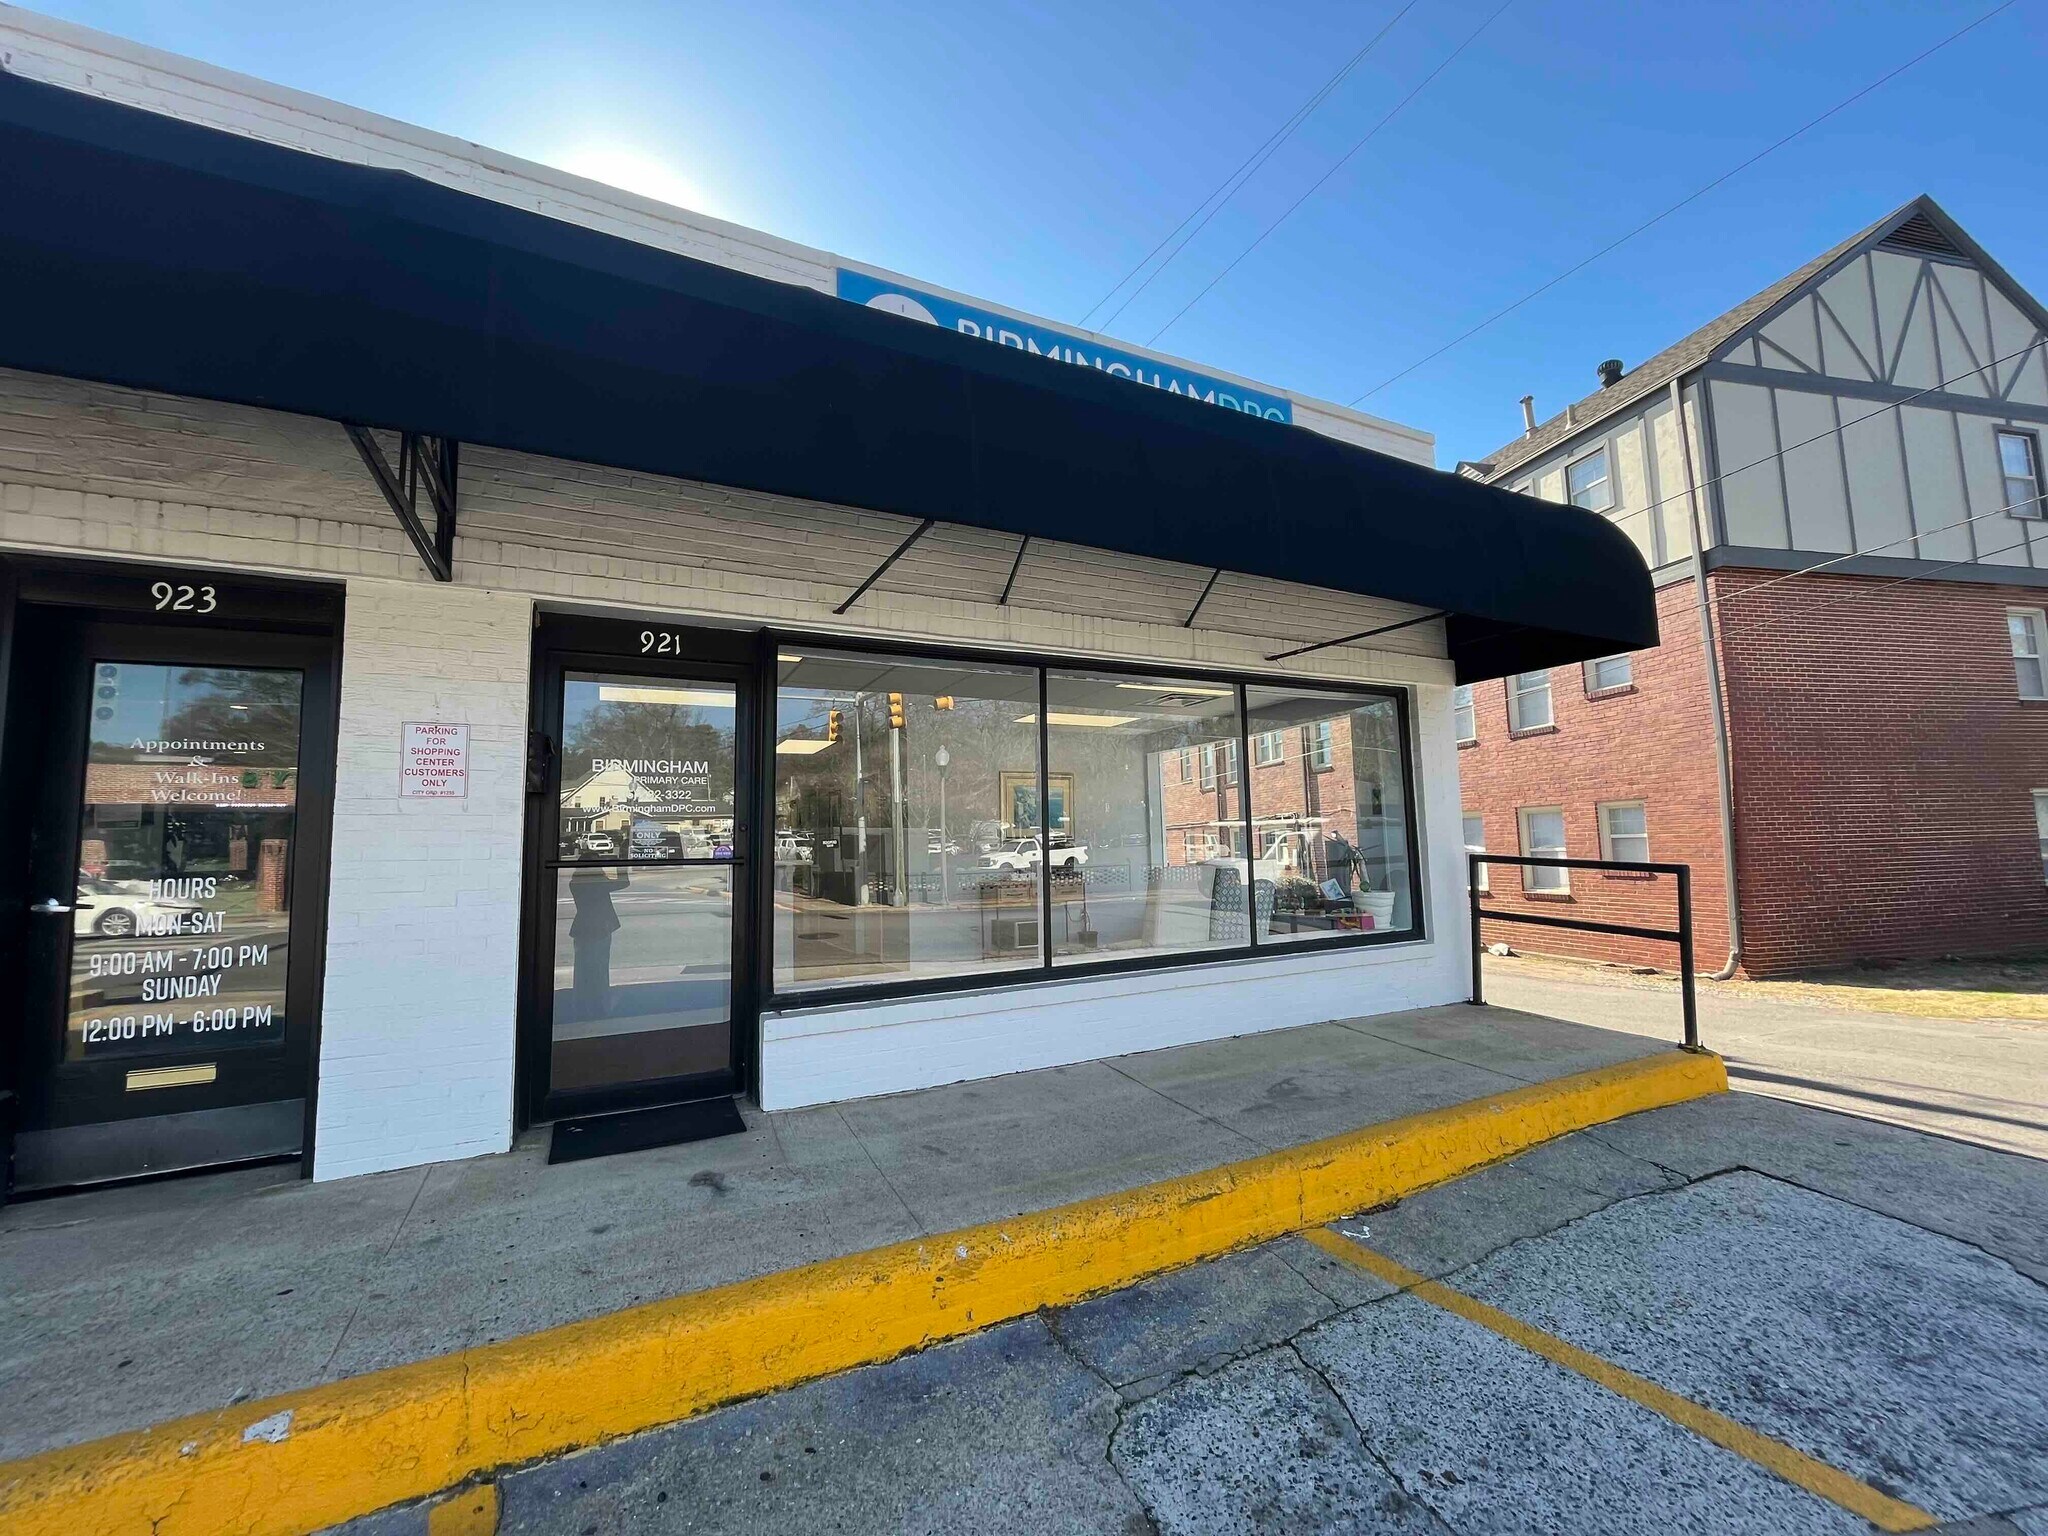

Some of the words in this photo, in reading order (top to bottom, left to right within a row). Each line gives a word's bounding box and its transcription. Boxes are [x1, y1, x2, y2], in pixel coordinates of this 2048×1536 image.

[151, 582, 217, 613] 923
[640, 630, 681, 655] 921
[415, 726, 458, 736] PARKING
[130, 737, 265, 753] Appointments
[426, 738, 447, 746] FOR
[410, 747, 461, 756] SHOPPING
[187, 755, 208, 767] &
[415, 757, 455, 766] CENTER
[591, 758, 709, 774] BIRMINGHAM
[155, 771, 239, 785] Walk-Ins
[404, 768, 465, 777] CUSTOMERS
[421, 779, 448, 787] ONLY
[634, 776, 679, 785] PRIMARY
[681, 776, 708, 785] CARE
[151, 789, 241, 802] Welcome!
[636, 831, 661, 839] ONLY
[149, 877, 217, 900] HOURS
[134, 911, 226, 937] MON-SAT
[89, 953, 136, 977] 9:00
[141, 950, 173, 974] AM
[192, 946, 233, 970] 7:00
[238, 944, 269, 967] PM
[142, 974, 222, 1002] SUNDAY
[82, 1016, 136, 1043] 12:00
[142, 1013, 173, 1038] PM
[192, 1008, 236, 1033] 6:00
[242, 1005, 272, 1027] PM
